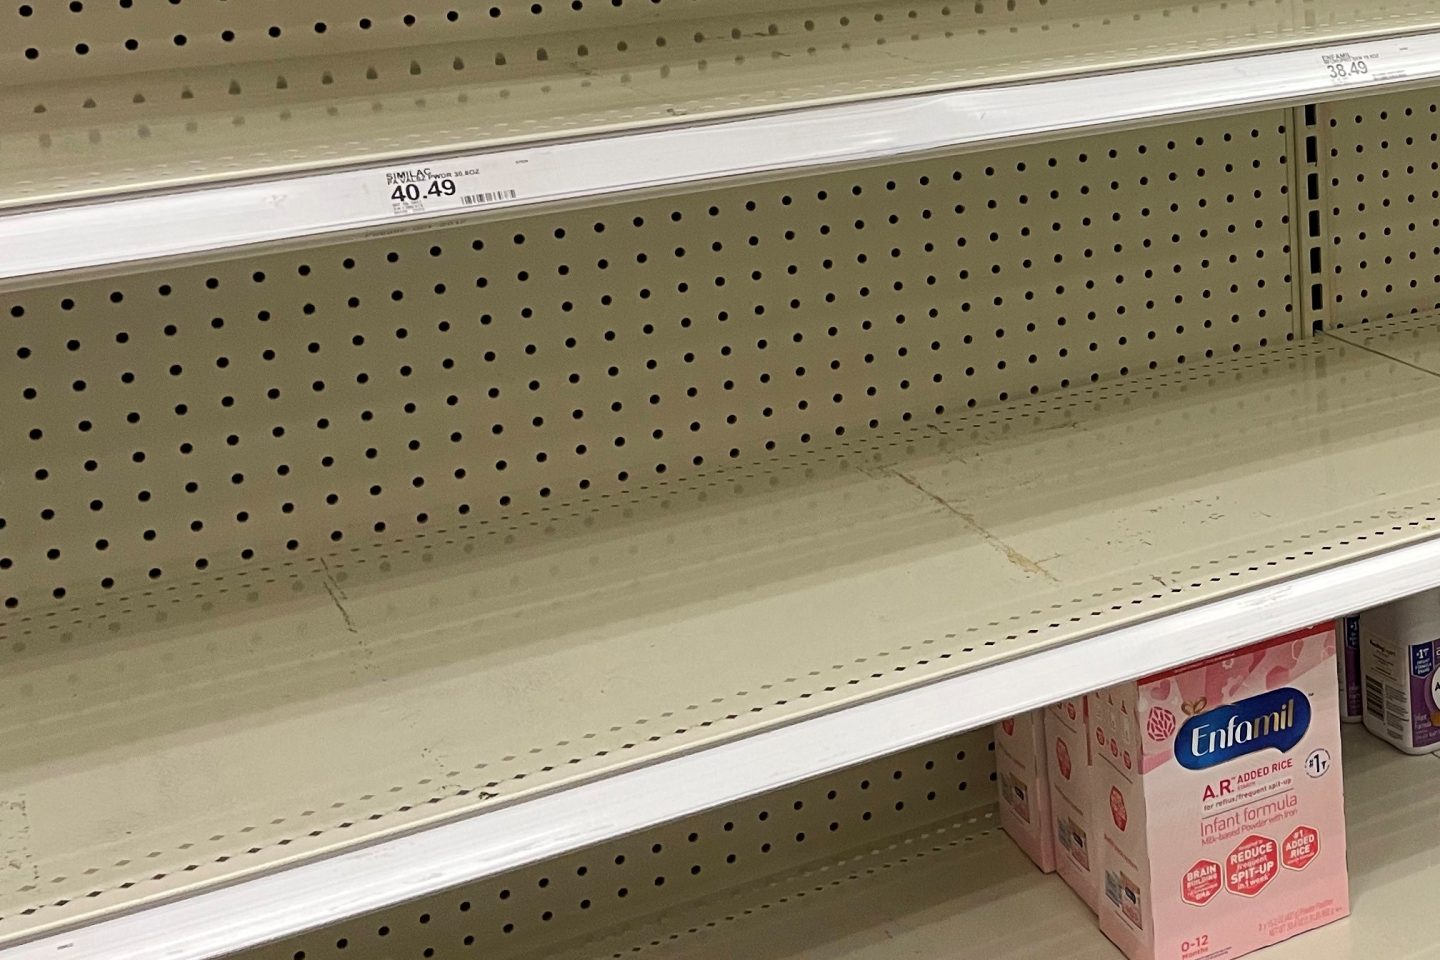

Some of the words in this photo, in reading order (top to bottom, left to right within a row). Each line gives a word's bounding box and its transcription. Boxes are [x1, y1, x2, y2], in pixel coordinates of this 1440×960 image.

[1327, 60, 1368, 78] 38.49
[386, 168, 432, 180] SIMILAC
[391, 179, 456, 202] 40.49
[1191, 698, 1295, 757] Enfamil
[1237, 765, 1269, 784] ADDED
[1271, 758, 1294, 772] RICE
[1201, 812, 1240, 837] Infant
[1244, 794, 1298, 823] formula
[1230, 841, 1273, 865] REDUCE
[1286, 834, 1315, 851] ADDED
[1290, 844, 1311, 858] RICE
[1186, 864, 1217, 882] BRAIN
[1230, 860, 1275, 885] SPIT-UP
[1181, 934, 1209, 953] 0-12
